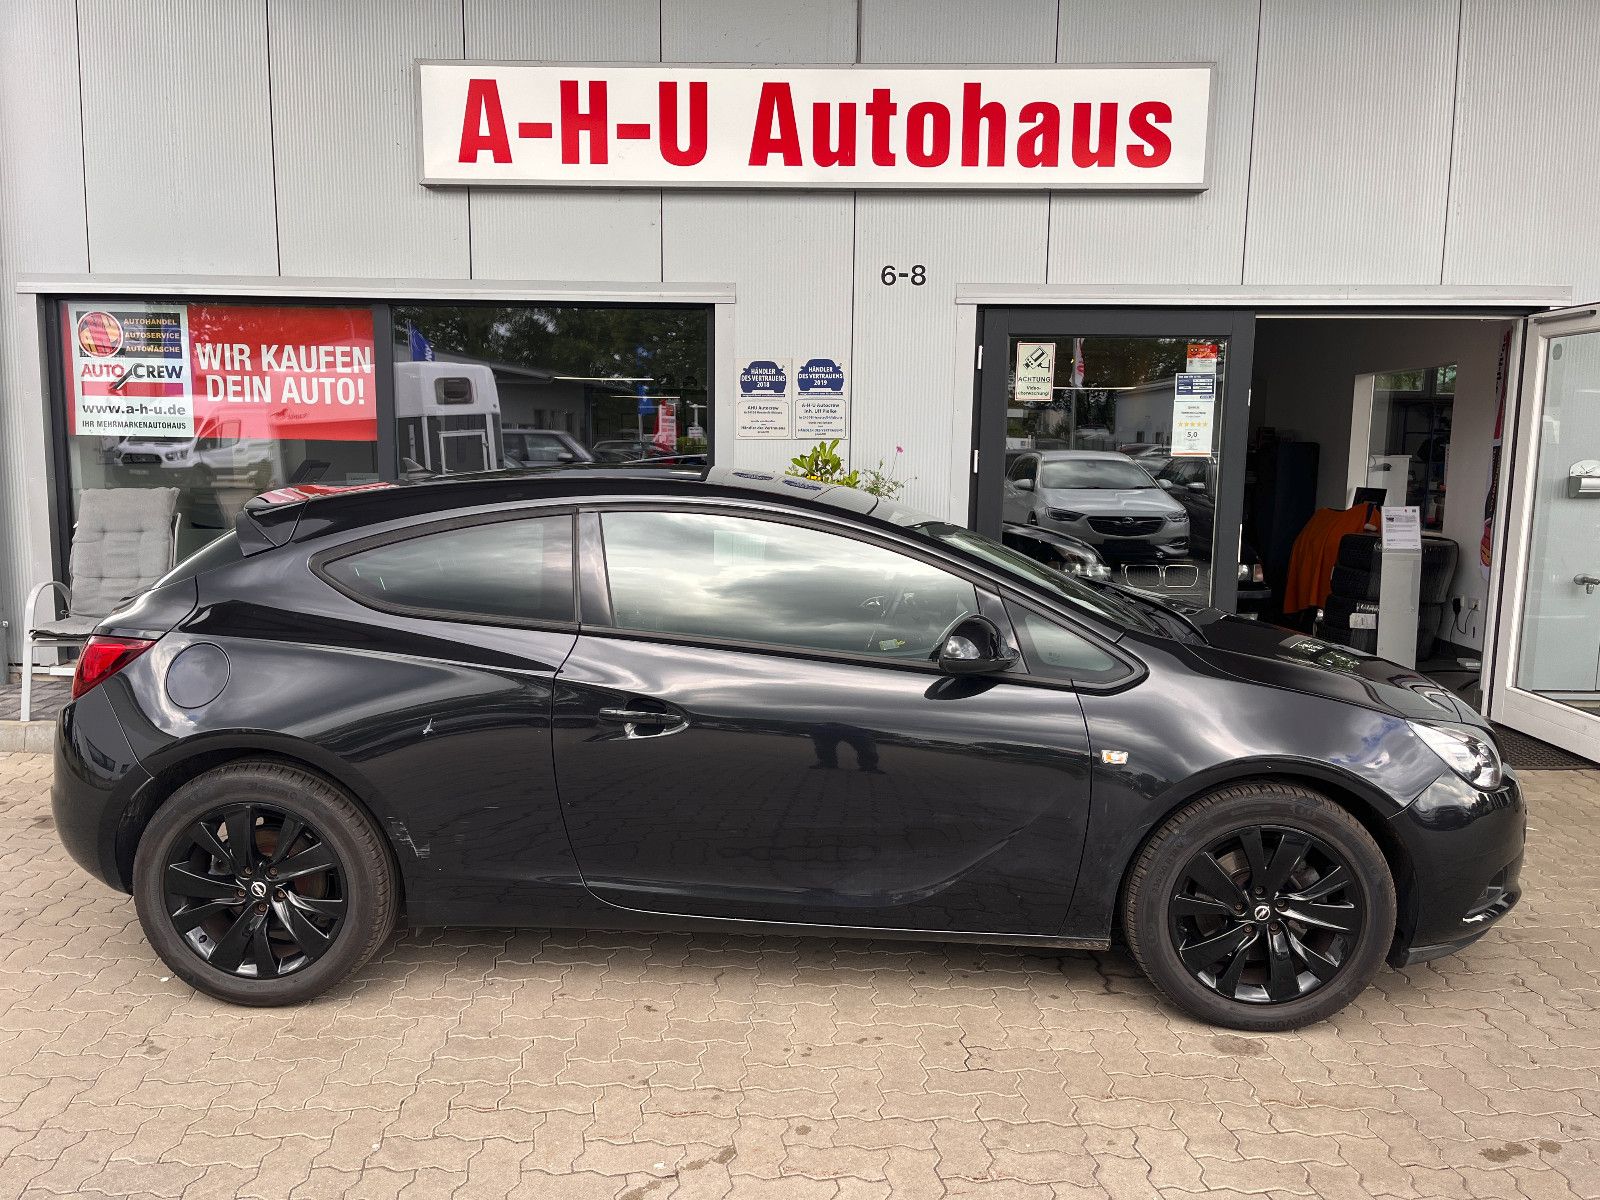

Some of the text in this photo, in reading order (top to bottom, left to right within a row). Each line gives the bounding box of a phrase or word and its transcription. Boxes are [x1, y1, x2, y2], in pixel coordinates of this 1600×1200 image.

[459, 79, 1172, 167] A-H-U Autohaus
[881, 265, 927, 286] 6-8
[195, 342, 372, 374] WIR KAUFEN
[81, 363, 183, 379] AUTO CREW
[750, 367, 776, 375] HÄNDLER
[808, 365, 833, 373] HÄNDLER
[741, 374, 752, 382] DES
[206, 375, 365, 405] DEIN AUTO!
[82, 404, 186, 416] www.a-h-u.de
[82, 420, 187, 430] IHR MEHRMARKENAUTOHAUS
